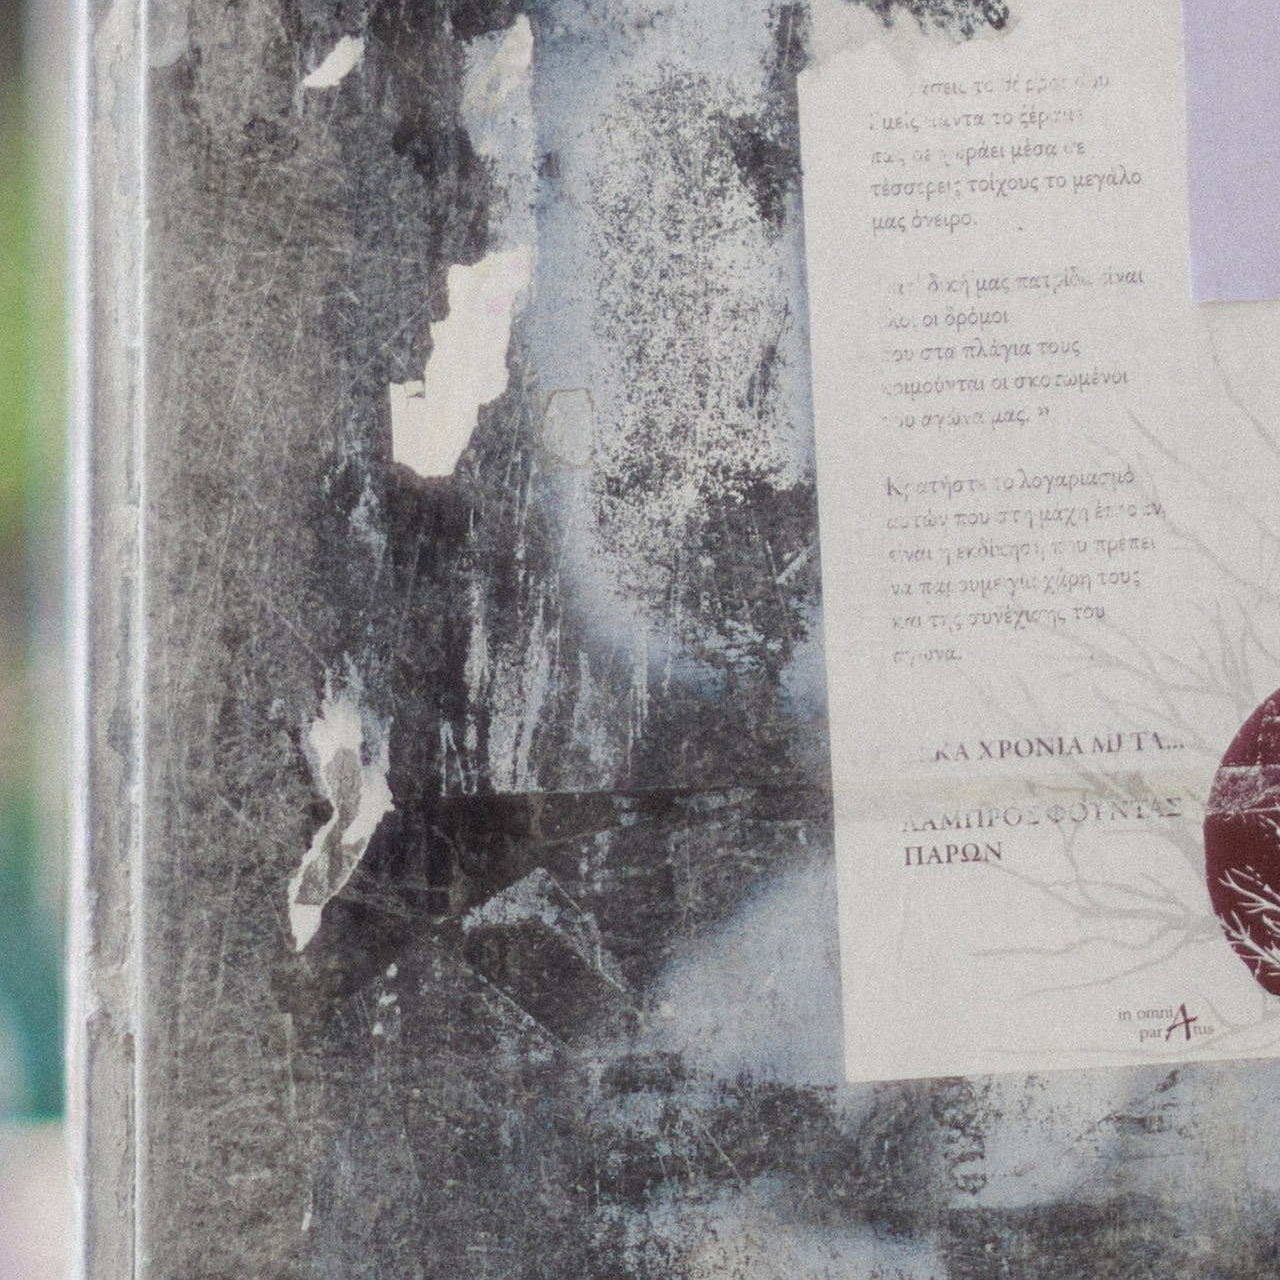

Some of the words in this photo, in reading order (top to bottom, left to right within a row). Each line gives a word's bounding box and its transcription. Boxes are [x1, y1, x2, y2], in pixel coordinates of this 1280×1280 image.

[1010, 137, 1057, 164] μέσα
[966, 172, 1039, 198] τοίχους
[1044, 175, 1067, 189] το
[1072, 165, 1142, 196] μεγάλο
[872, 214, 906, 237] μας
[911, 208, 977, 233] όνειρο.
[976, 275, 1010, 298] μας
[922, 313, 939, 327] οι
[945, 305, 1008, 332] δρόμοι
[920, 346, 955, 361] στα
[962, 337, 1031, 362] πλάγια
[1037, 339, 1080, 356] τους
[991, 376, 1008, 390] οι
[1015, 366, 1128, 395] σκοτωμένοι
[1018, 465, 1135, 494] λογαριασμό
[954, 509, 990, 527] που
[1039, 501, 1089, 528] μάχη
[1072, 605, 1105, 622] του
[977, 735, 1083, 760] ΧΡΟΝΙΑ
[903, 841, 1003, 867] ΠΑΡΩΝ
[1118, 1008, 1131, 1021] in
